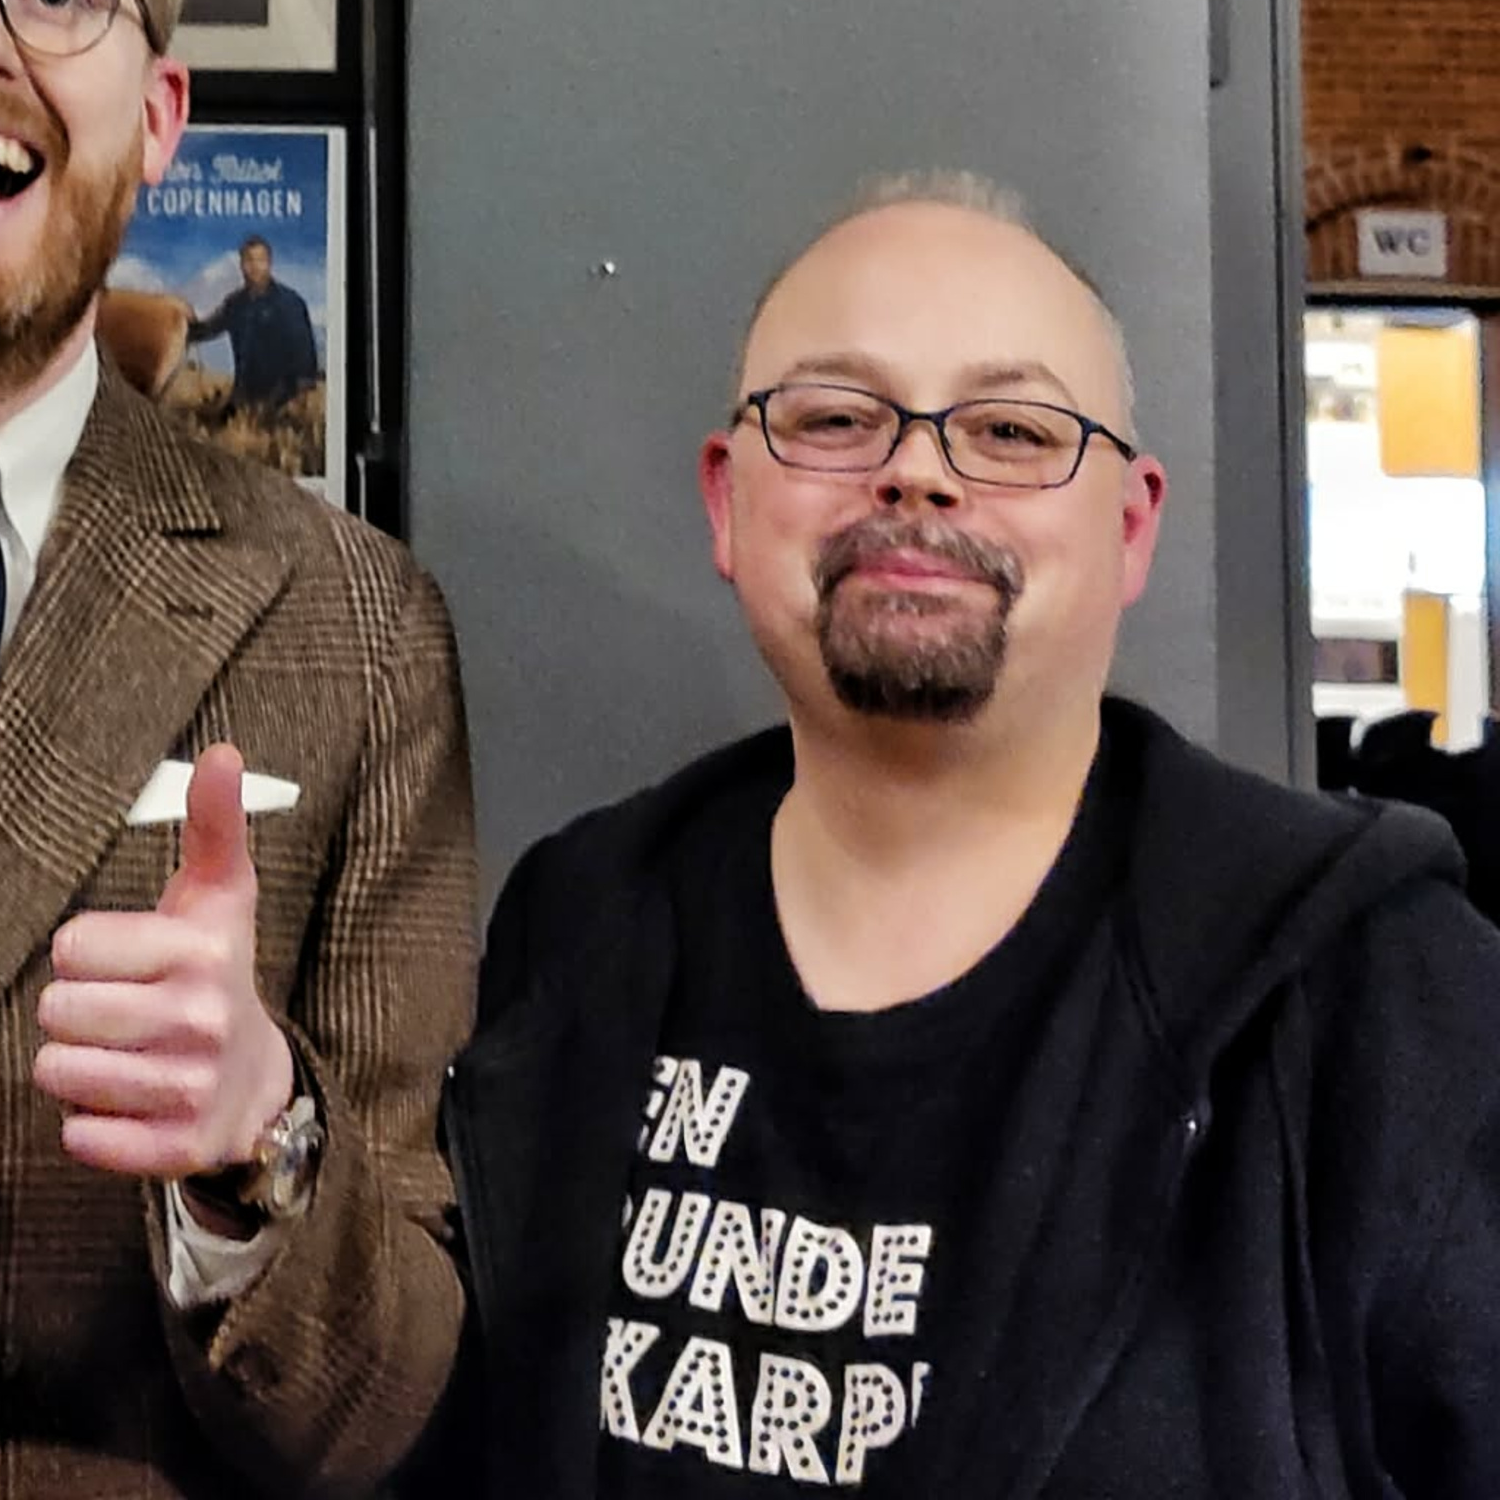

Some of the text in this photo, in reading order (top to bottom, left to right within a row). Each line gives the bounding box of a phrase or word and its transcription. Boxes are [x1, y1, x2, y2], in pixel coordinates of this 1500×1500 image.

[146, 186, 303, 216] COPENHAGEN
[1373, 229, 1431, 256] WC
[621, 1188, 933, 1337] UNDE
[600, 1316, 933, 1486] KARP
